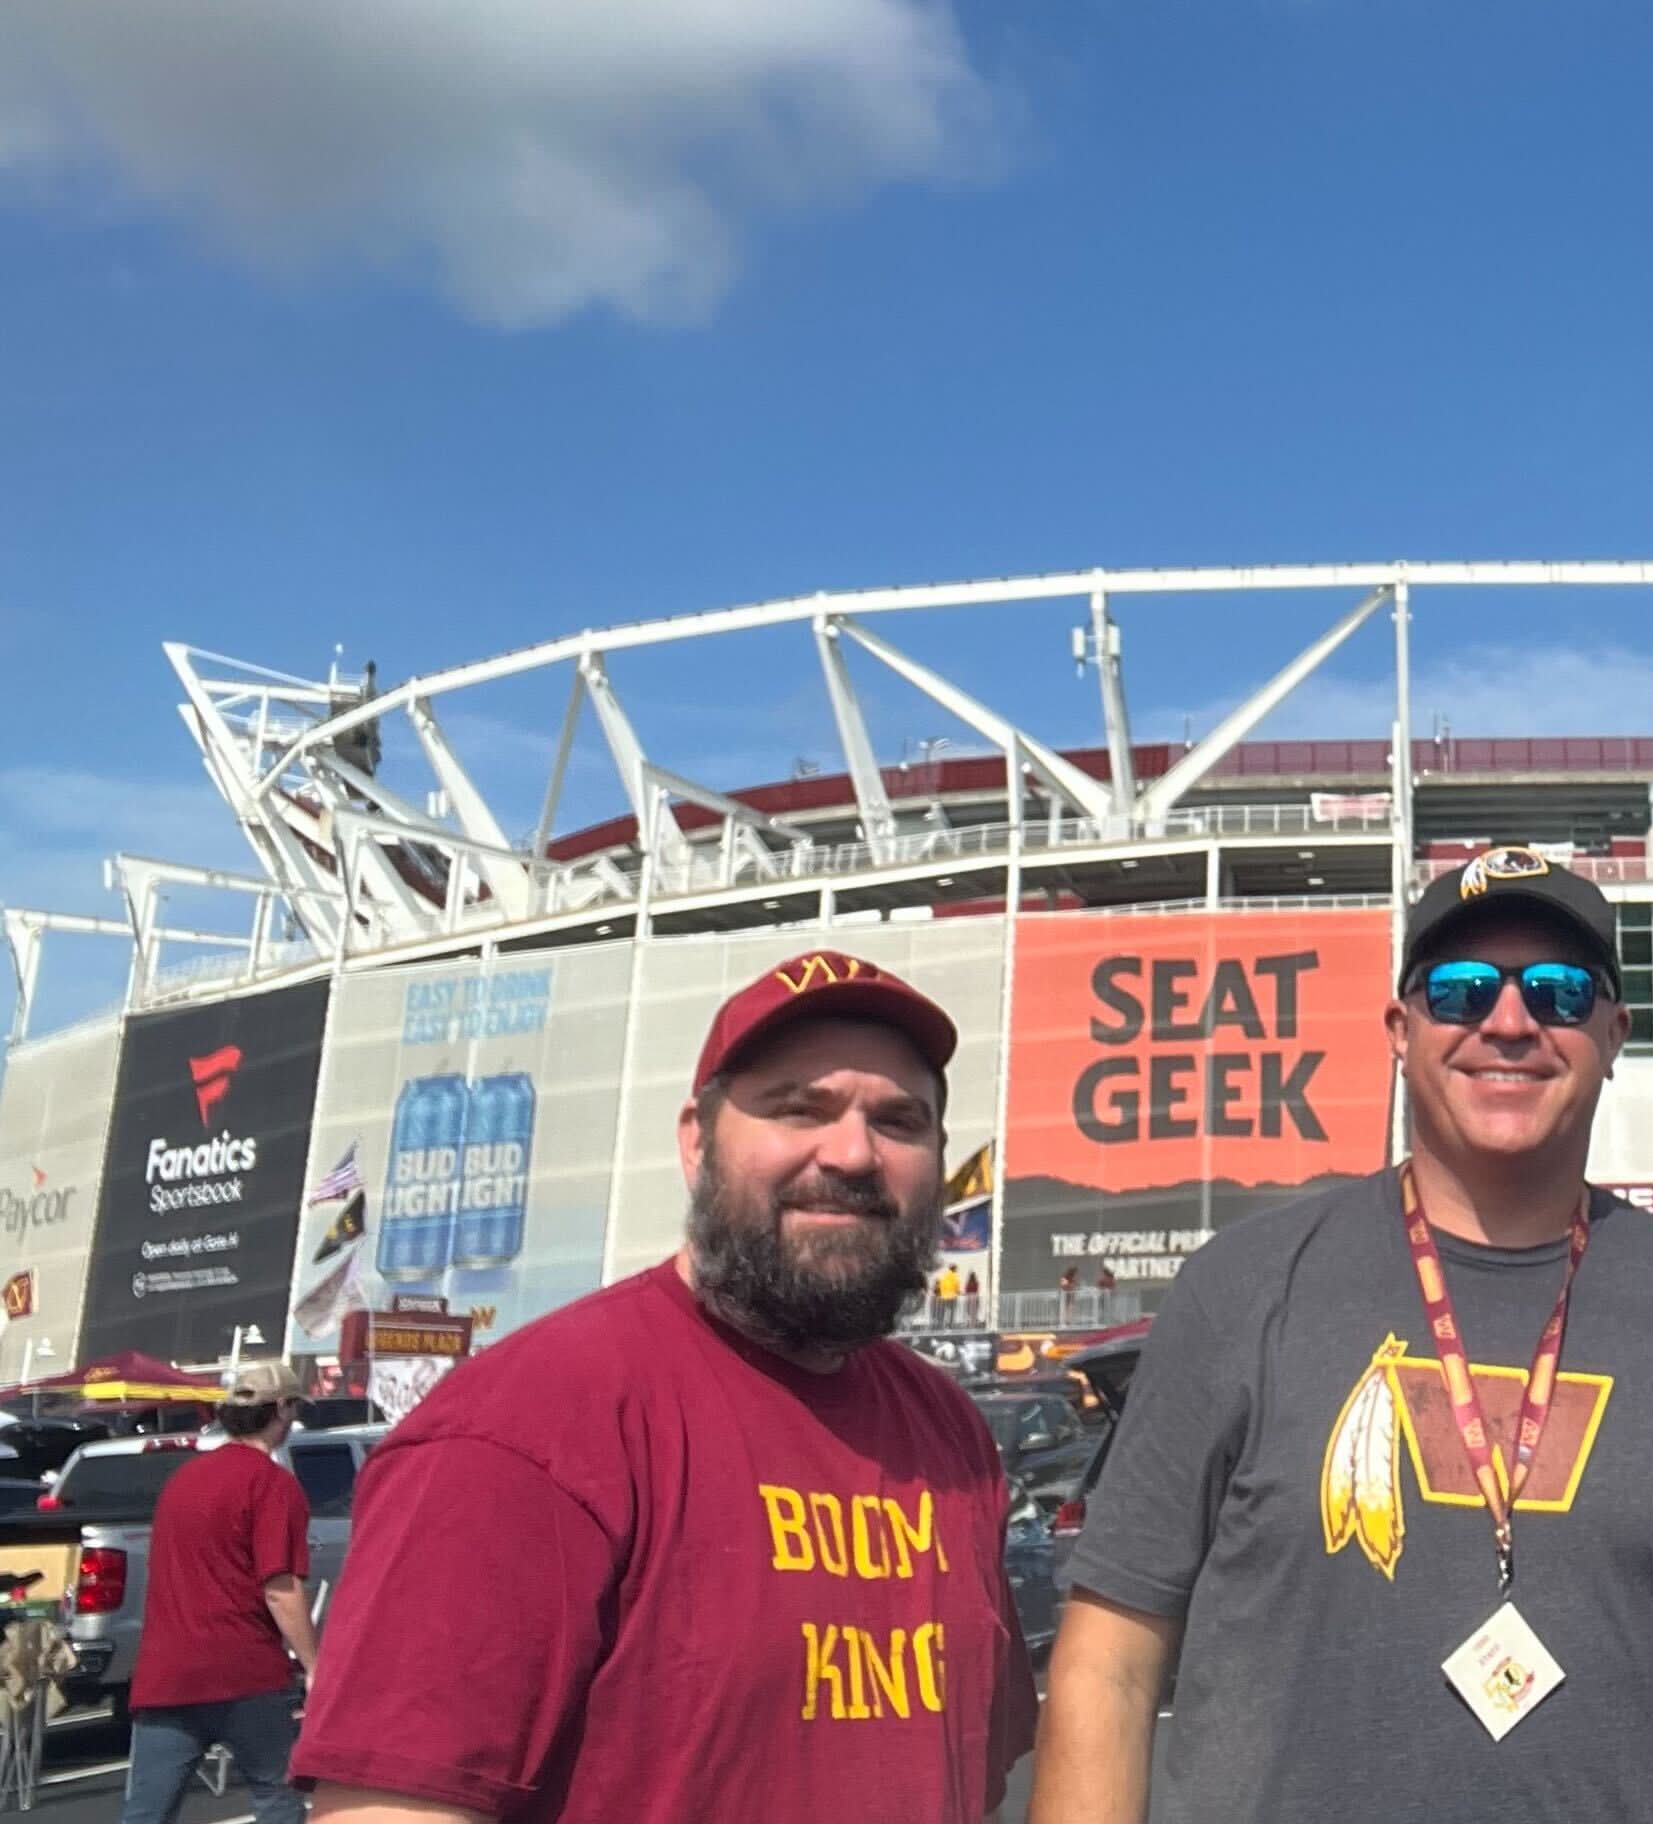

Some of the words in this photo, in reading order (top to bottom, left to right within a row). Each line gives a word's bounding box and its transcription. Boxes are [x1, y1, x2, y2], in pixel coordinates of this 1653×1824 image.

[1091, 949, 1321, 1047] SEAT
[1072, 1050, 1330, 1146] GEEK
[145, 1129, 257, 1184] Fanatics
[396, 1146, 457, 1183] BUD
[463, 1141, 523, 1178] BUD
[150, 1176, 243, 1216] Sportsbook
[1051, 1232, 1086, 1257] THE
[1087, 1231, 1167, 1256] OFFICIAL
[757, 1483, 949, 1580] BOOM
[801, 1621, 945, 1721] KING
